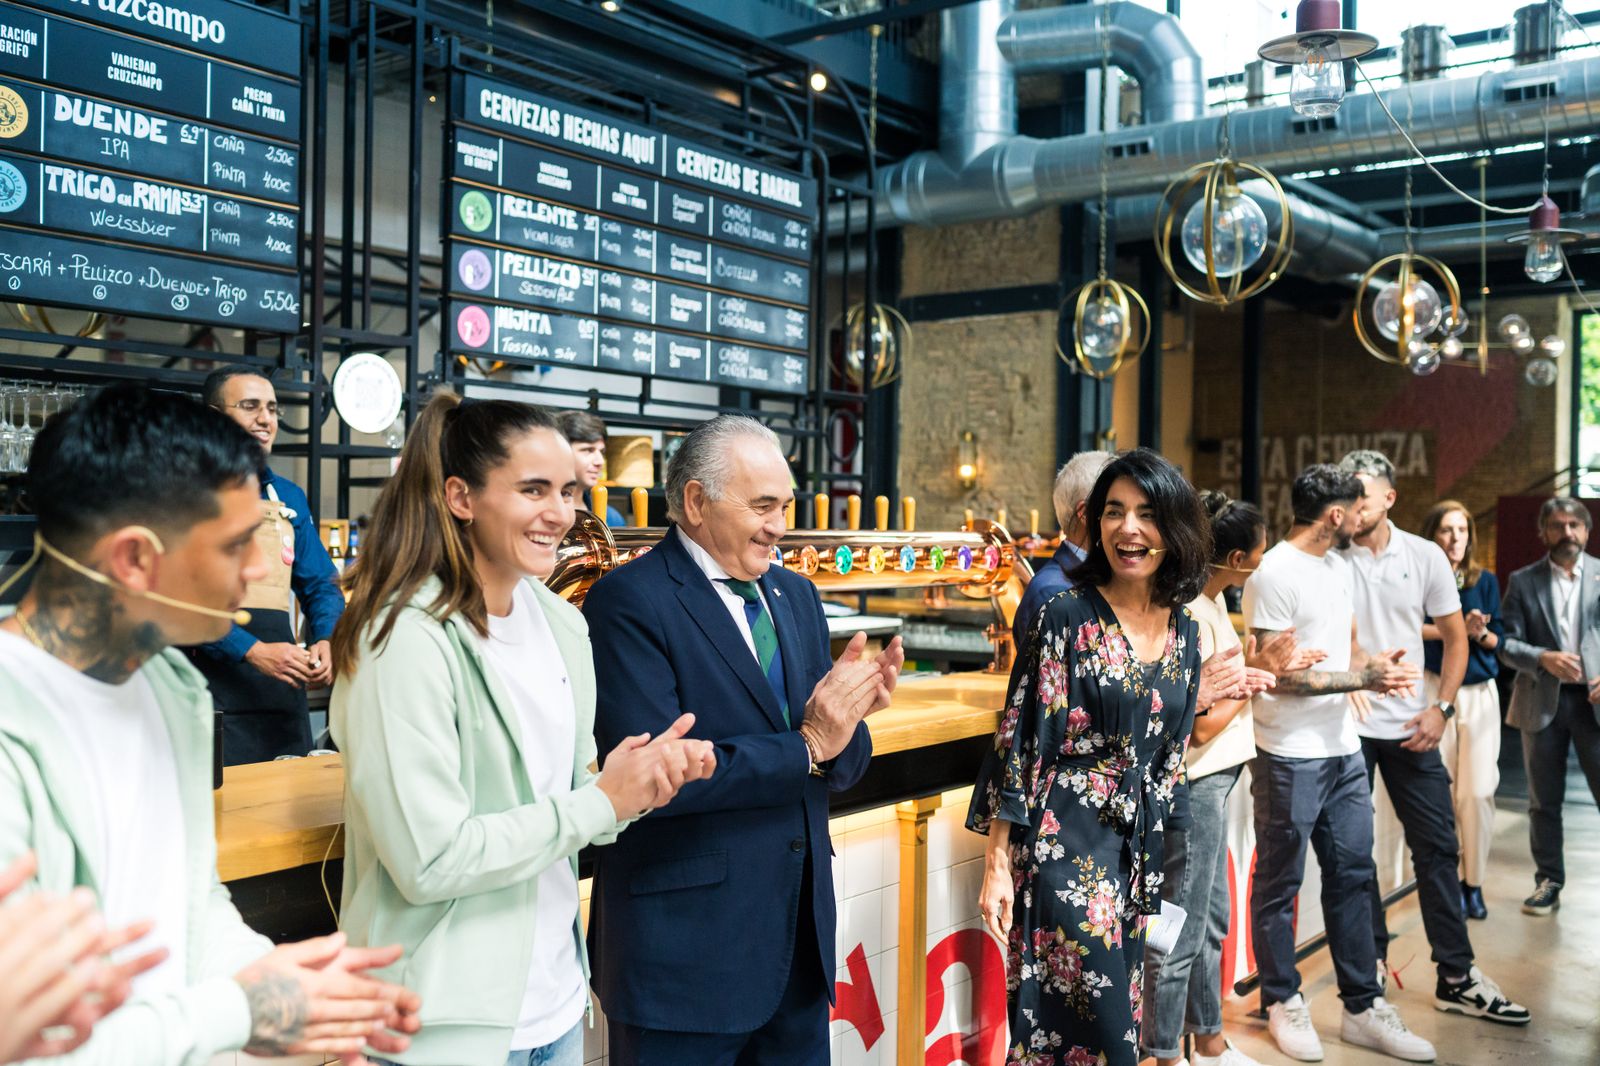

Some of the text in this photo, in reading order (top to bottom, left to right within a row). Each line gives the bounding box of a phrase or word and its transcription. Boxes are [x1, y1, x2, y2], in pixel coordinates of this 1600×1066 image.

[69, 0, 226, 44] uzcampo
[111, 52, 157, 75] VARIEDAD
[107, 67, 163, 91] CRUZCAMPO
[244, 86, 273, 105] PRECIO
[54, 94, 168, 144] DUENDE
[232, 98, 254, 114] CAÑA
[263, 107, 286, 122] PINTA
[480, 89, 656, 164] CERVEZAS HECHAS AQUÍ
[101, 137, 130, 161] IPA
[214, 135, 245, 155] CAÑA
[677, 146, 802, 208] CERVEZAS DE BARRIL
[133, 181, 182, 216] RAMA
[503, 195, 578, 230] RELENTE
[90, 210, 176, 238] Weissbier
[213, 200, 295, 229] CAÑA 2,50€
[0, 251, 51, 277] SCARÁ
[259, 289, 300, 315] 5,50€
[464, 321, 473, 341] 7
[502, 336, 549, 357] TOSTADA
[1220, 437, 1288, 480] ETA
